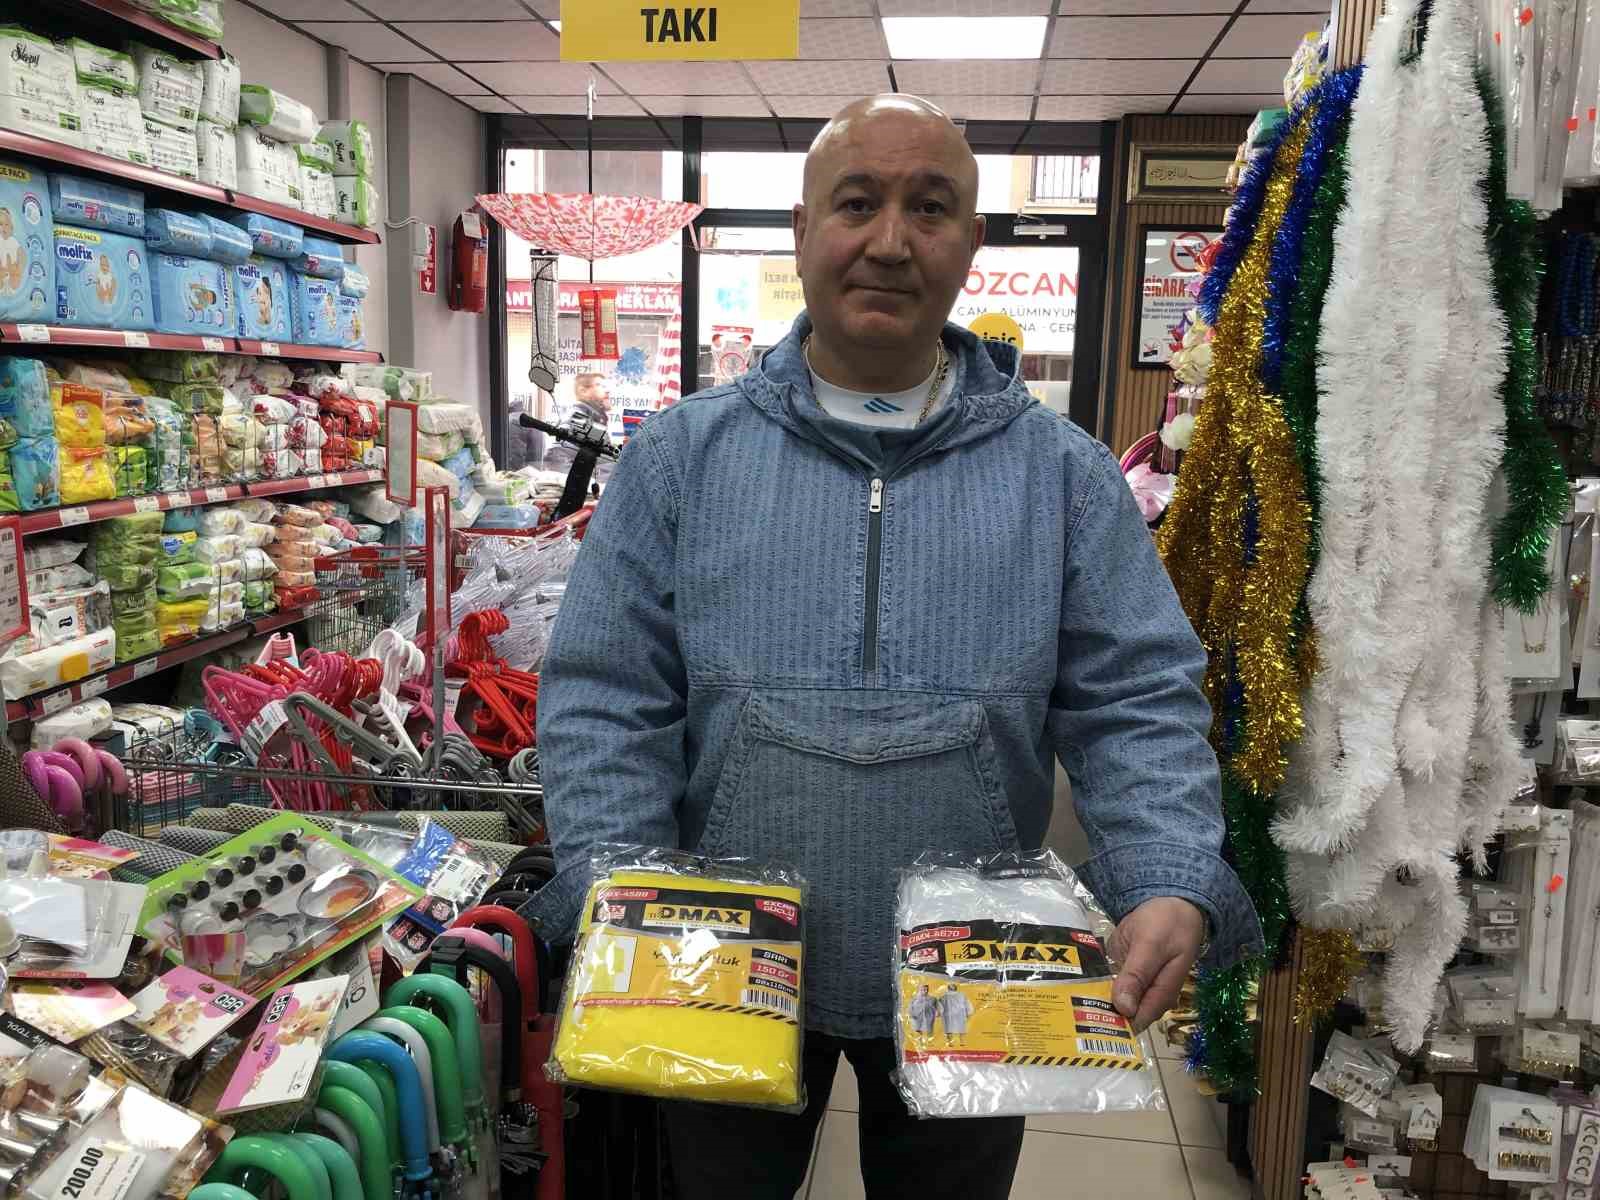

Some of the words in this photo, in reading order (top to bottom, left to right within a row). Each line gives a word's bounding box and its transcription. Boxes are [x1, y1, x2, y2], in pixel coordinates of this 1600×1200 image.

[641, 8, 717, 42] TAKI
[59, 243, 94, 262] molfix
[964, 264, 1077, 297] ÖZCAN
[957, 306, 988, 316] CAM
[660, 906, 744, 925] DMAX
[961, 943, 1072, 964] DMAX
[62, 1147, 104, 1198] 200.00
